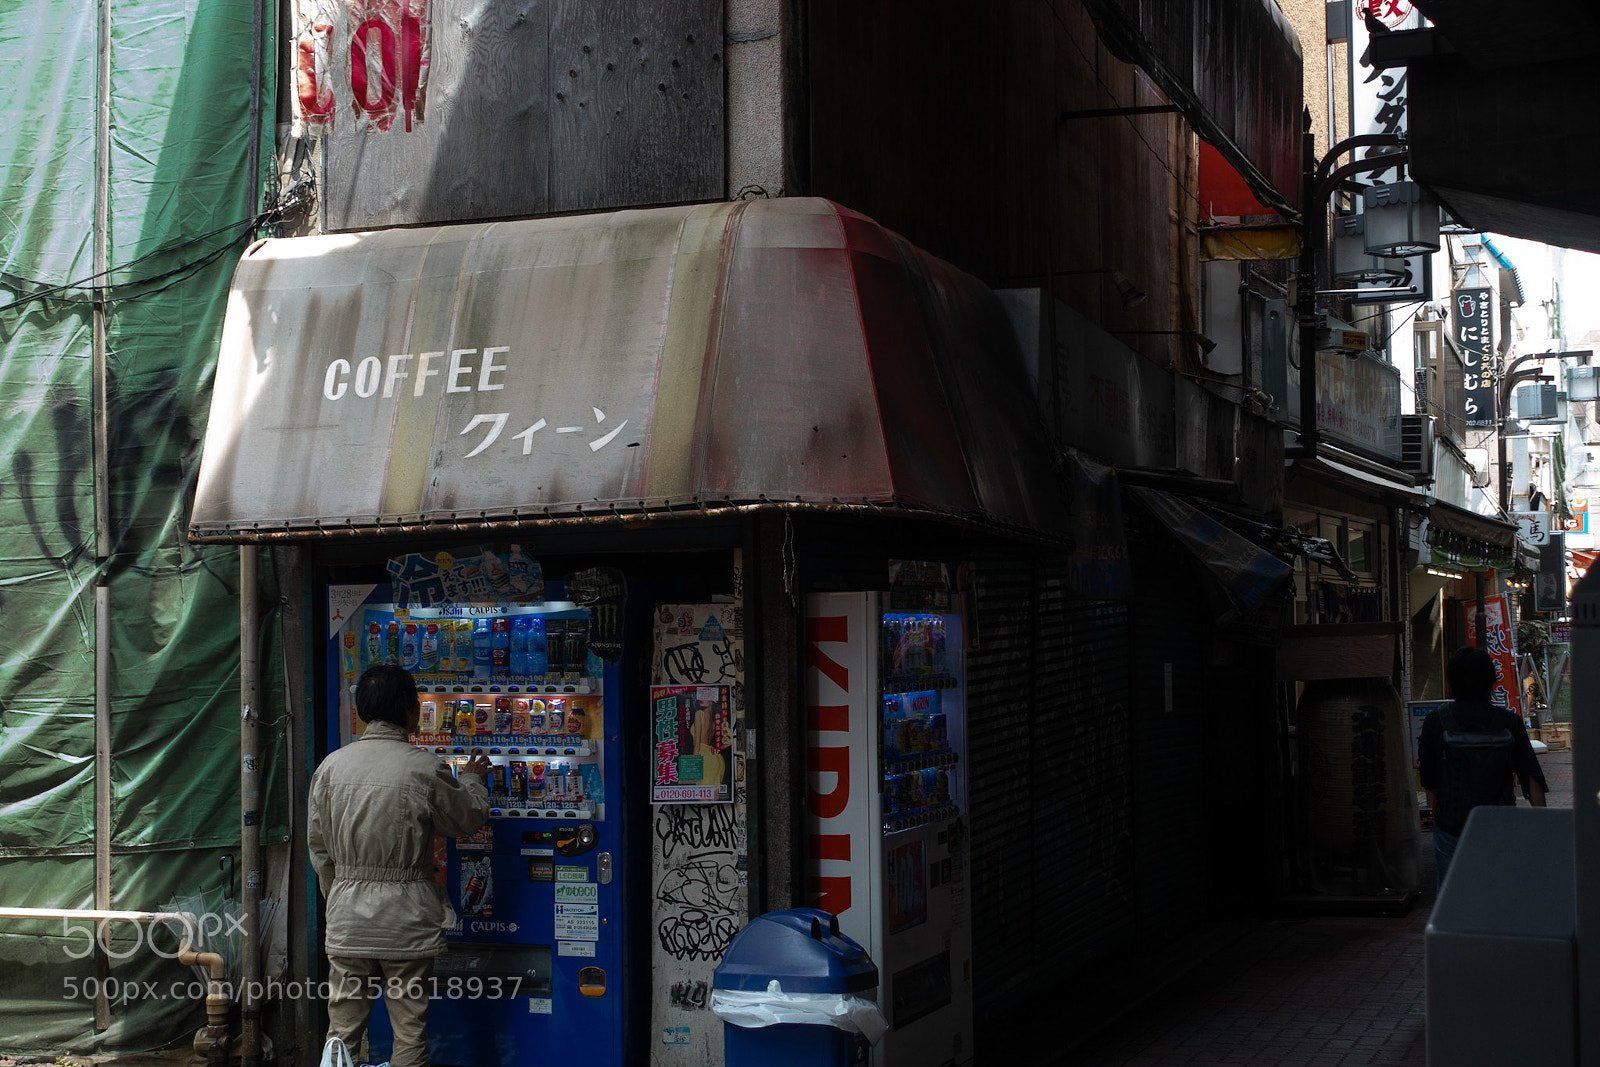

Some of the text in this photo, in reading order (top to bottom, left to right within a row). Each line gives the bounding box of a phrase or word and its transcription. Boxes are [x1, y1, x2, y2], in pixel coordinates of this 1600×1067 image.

[323, 345, 511, 401] COFFEE
[1460, 326, 1479, 415] にしむら
[459, 406, 629, 459] クィーン
[386, 552, 446, 608] 冷
[442, 565, 466, 583] えて
[469, 607, 498, 616] CALPIS
[656, 696, 679, 785] 男性募集
[806, 616, 852, 916] KIRI
[471, 921, 506, 933] CALPIS
